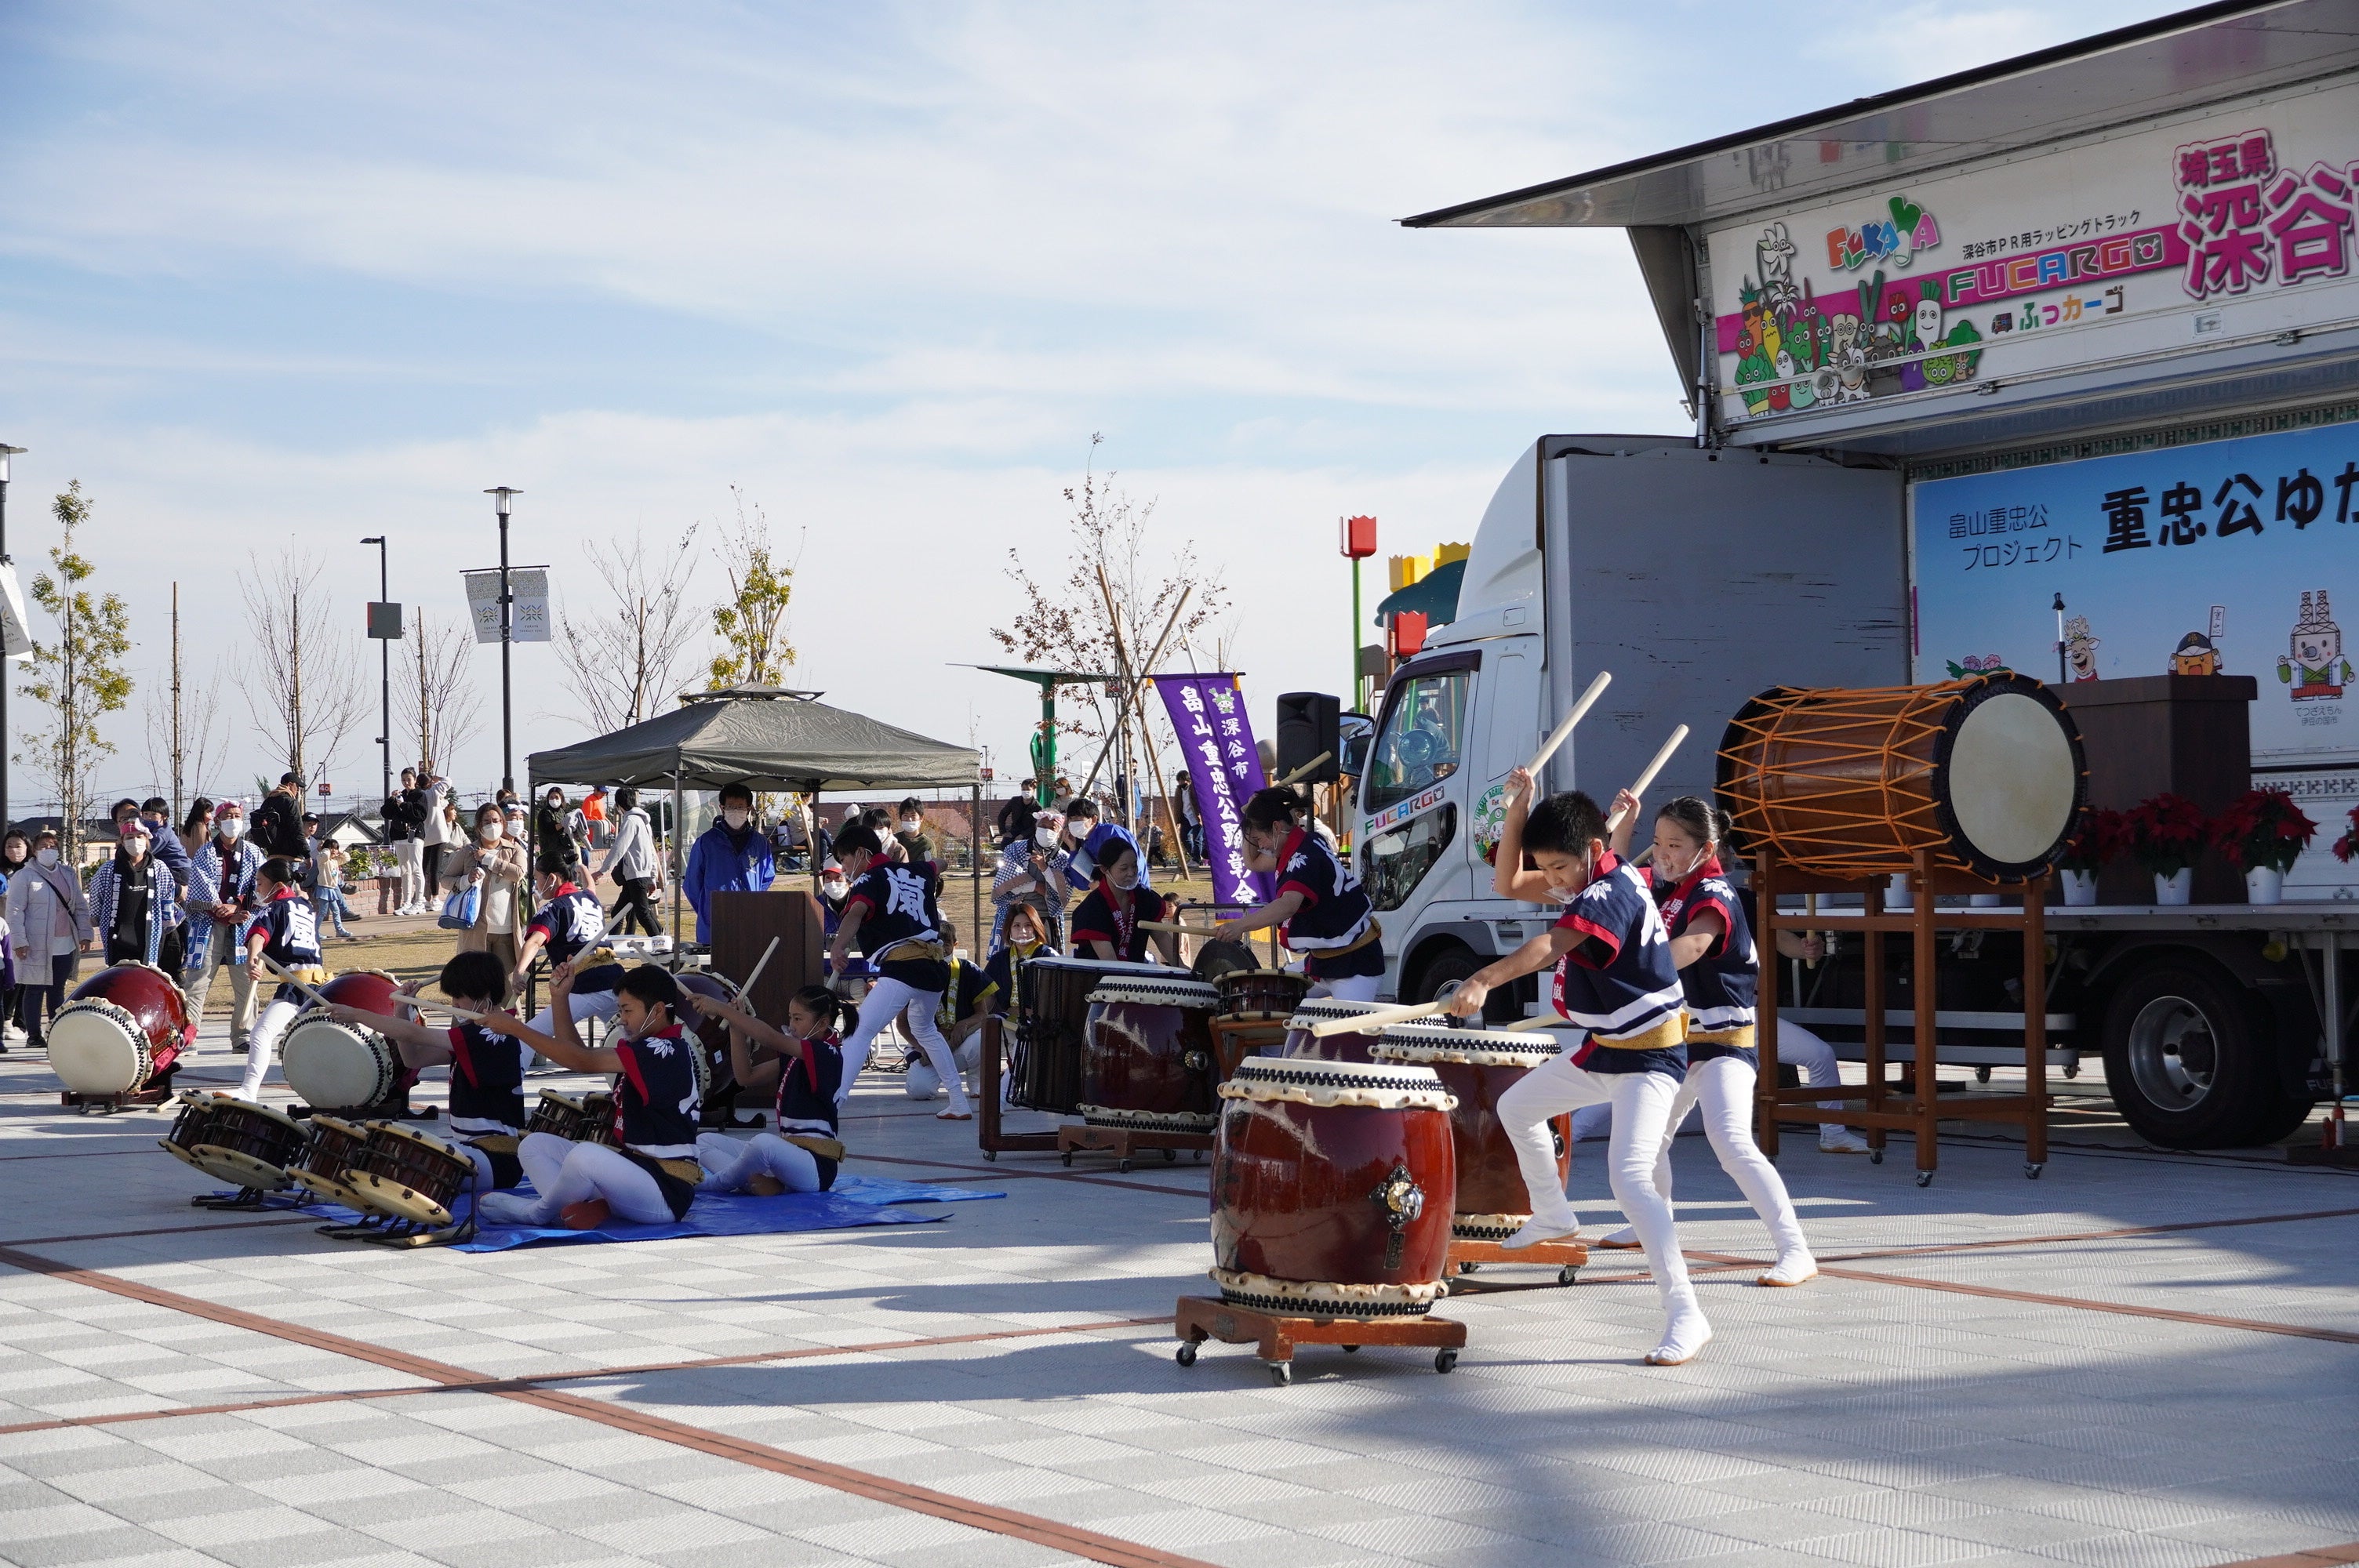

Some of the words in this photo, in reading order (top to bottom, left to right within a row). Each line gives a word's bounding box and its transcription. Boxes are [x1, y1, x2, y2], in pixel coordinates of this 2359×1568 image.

[2179, 136, 2269, 188] 埼玉県
[1826, 195, 1939, 270] FUKAYA
[2183, 168, 2359, 291] 深谷
[1947, 232, 2164, 303] FUCARGO
[2019, 285, 2125, 331] ふっカーゴ
[1962, 535, 2083, 571] プロジェクト
[1220, 717, 1249, 780] 深谷市
[1365, 786, 1445, 836] FUCARGO
